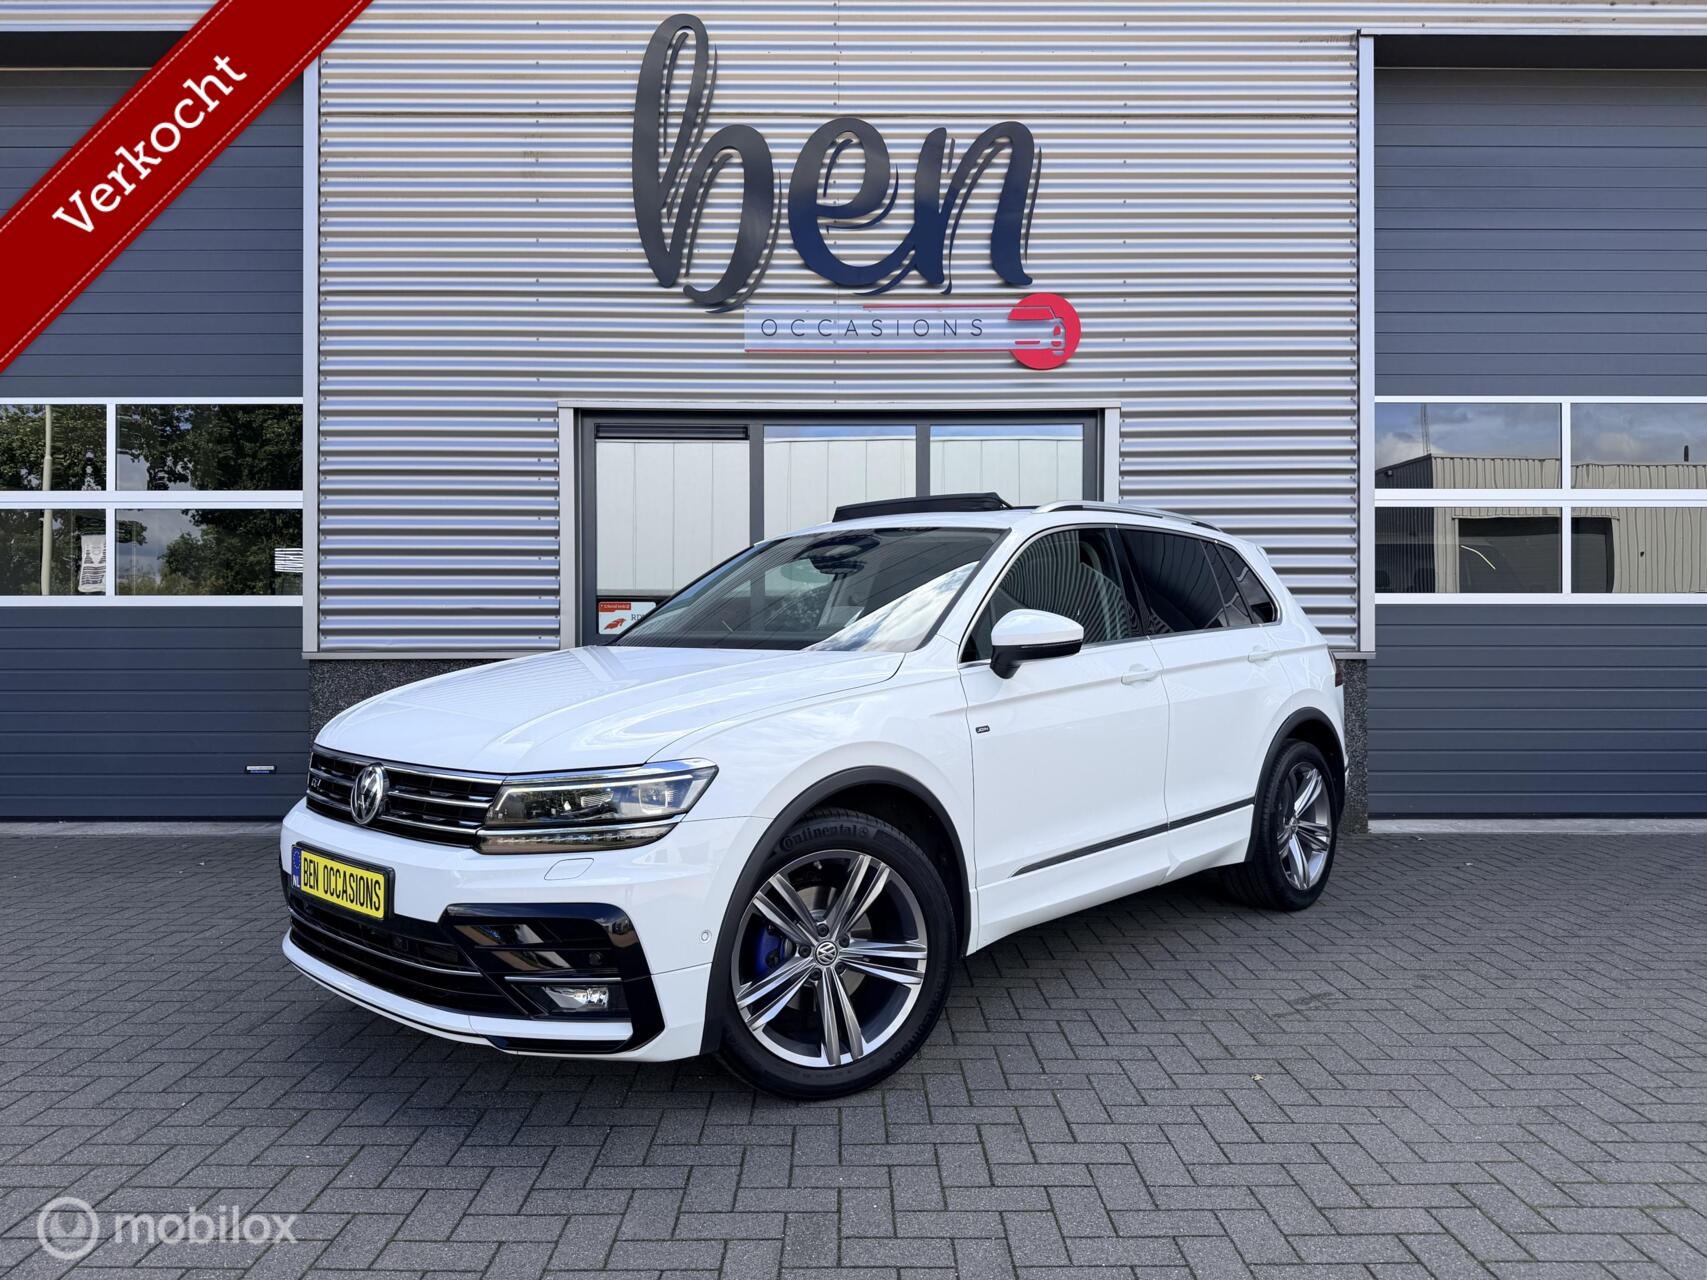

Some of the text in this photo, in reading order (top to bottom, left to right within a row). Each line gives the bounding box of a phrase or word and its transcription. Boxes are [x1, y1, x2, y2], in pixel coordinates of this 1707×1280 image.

[632, 13, 1041, 313] ben
[761, 319, 983, 337] OCCASIONS
[780, 824, 856, 850] Continental
[304, 857, 381, 911] BEN OCCASIONS
